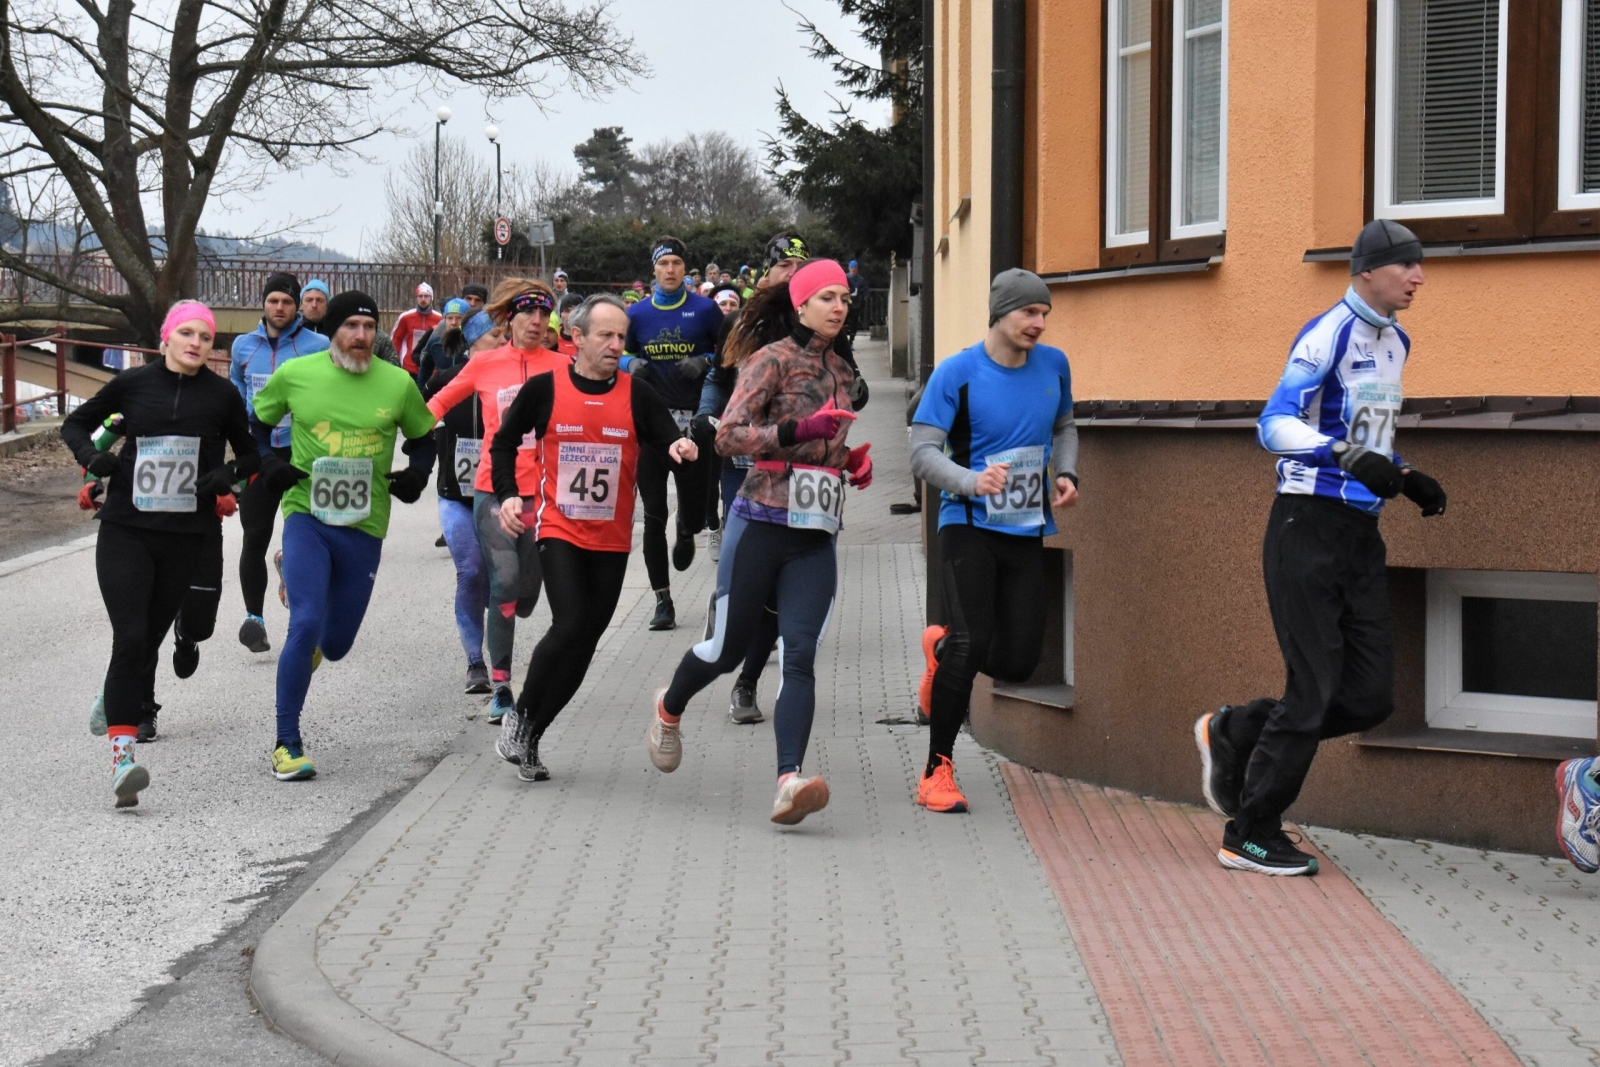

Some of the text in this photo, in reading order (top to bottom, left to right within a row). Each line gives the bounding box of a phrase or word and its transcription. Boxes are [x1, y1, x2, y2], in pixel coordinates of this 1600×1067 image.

[644, 343, 695, 354] TRUTNOV
[342, 447, 362, 457] CUP
[457, 446, 481, 454] BĚŽECK
[560, 454, 618, 464] BĚŽECKÁ LIGA
[561, 445, 586, 454] ZIMNÍ
[137, 460, 196, 495] 672
[457, 458, 481, 483] 2
[313, 477, 368, 510] 663
[569, 467, 609, 503] 45
[795, 472, 841, 517] 661
[1242, 840, 1268, 860] HOKA
